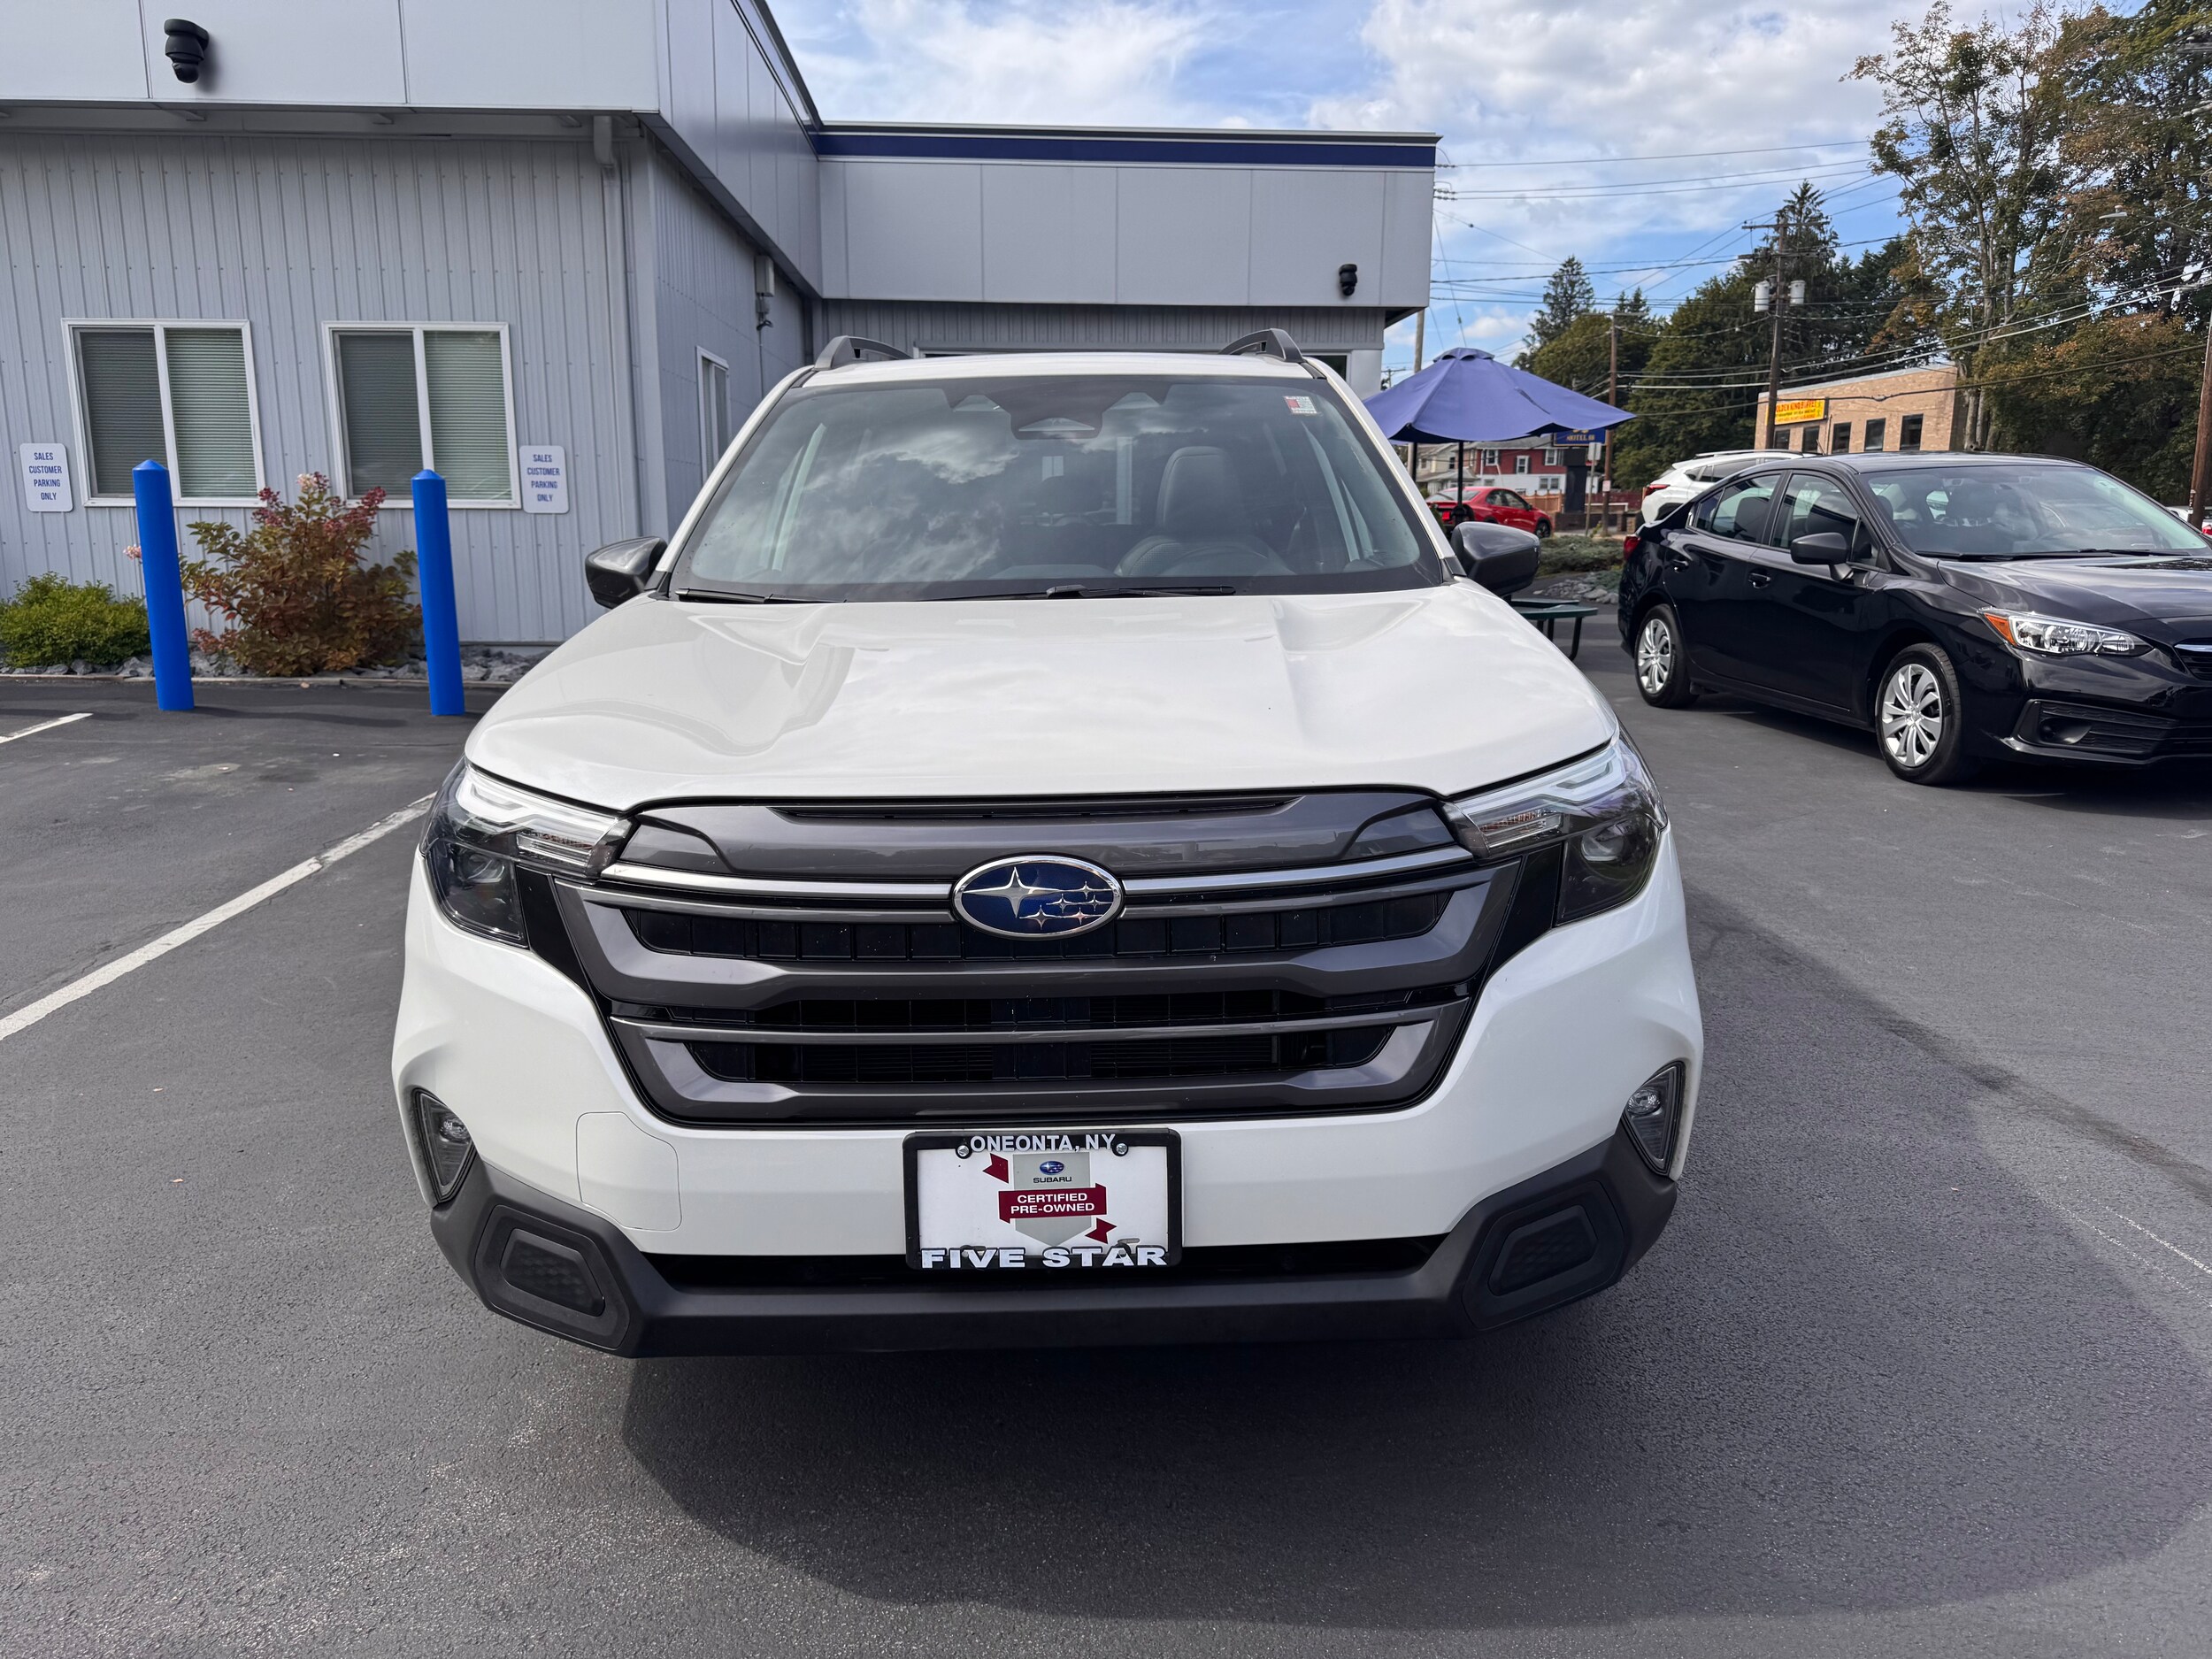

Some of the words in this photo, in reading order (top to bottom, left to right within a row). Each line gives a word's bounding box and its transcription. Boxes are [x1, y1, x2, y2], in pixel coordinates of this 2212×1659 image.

[34, 452, 53, 461] SALES
[533, 454, 552, 463] SALES
[28, 465, 62, 474] CUSTOMER
[527, 467, 560, 476] CUSTOMER
[34, 479, 60, 488] PARKING
[531, 480, 557, 489] PARKING
[41, 492, 57, 501] ONLY
[970, 1135, 1080, 1152] ONEONTA,
[1086, 1133, 1116, 1150] NY
[1017, 1193, 1087, 1203] CERTIFIED
[1010, 1202, 1095, 1214] PRE-OWNED
[921, 1248, 1026, 1269] FIVE
[1042, 1248, 1167, 1268] STAR
